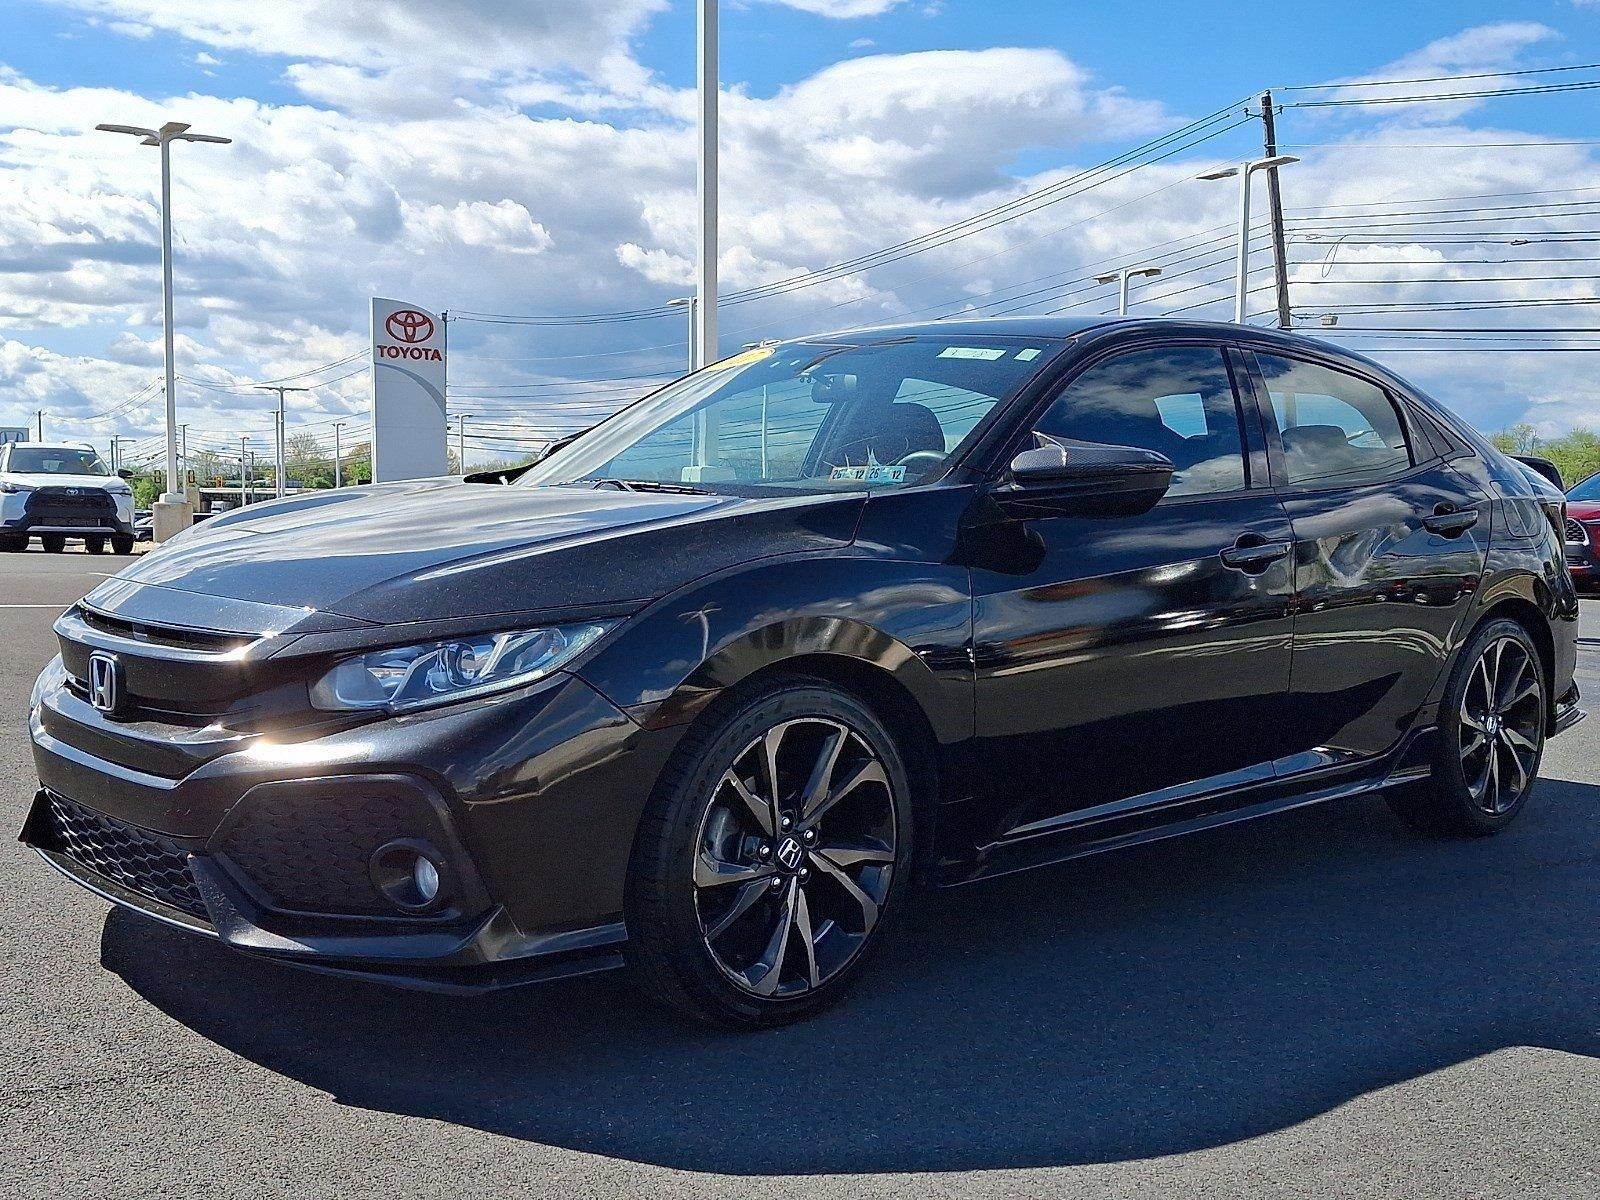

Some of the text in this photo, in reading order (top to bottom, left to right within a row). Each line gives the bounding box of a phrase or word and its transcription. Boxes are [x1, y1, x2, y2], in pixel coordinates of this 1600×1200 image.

[376, 345, 443, 362] TOYOTA
[855, 469, 865, 480] 12
[869, 468, 880, 479] 26
[892, 469, 902, 480] 12
